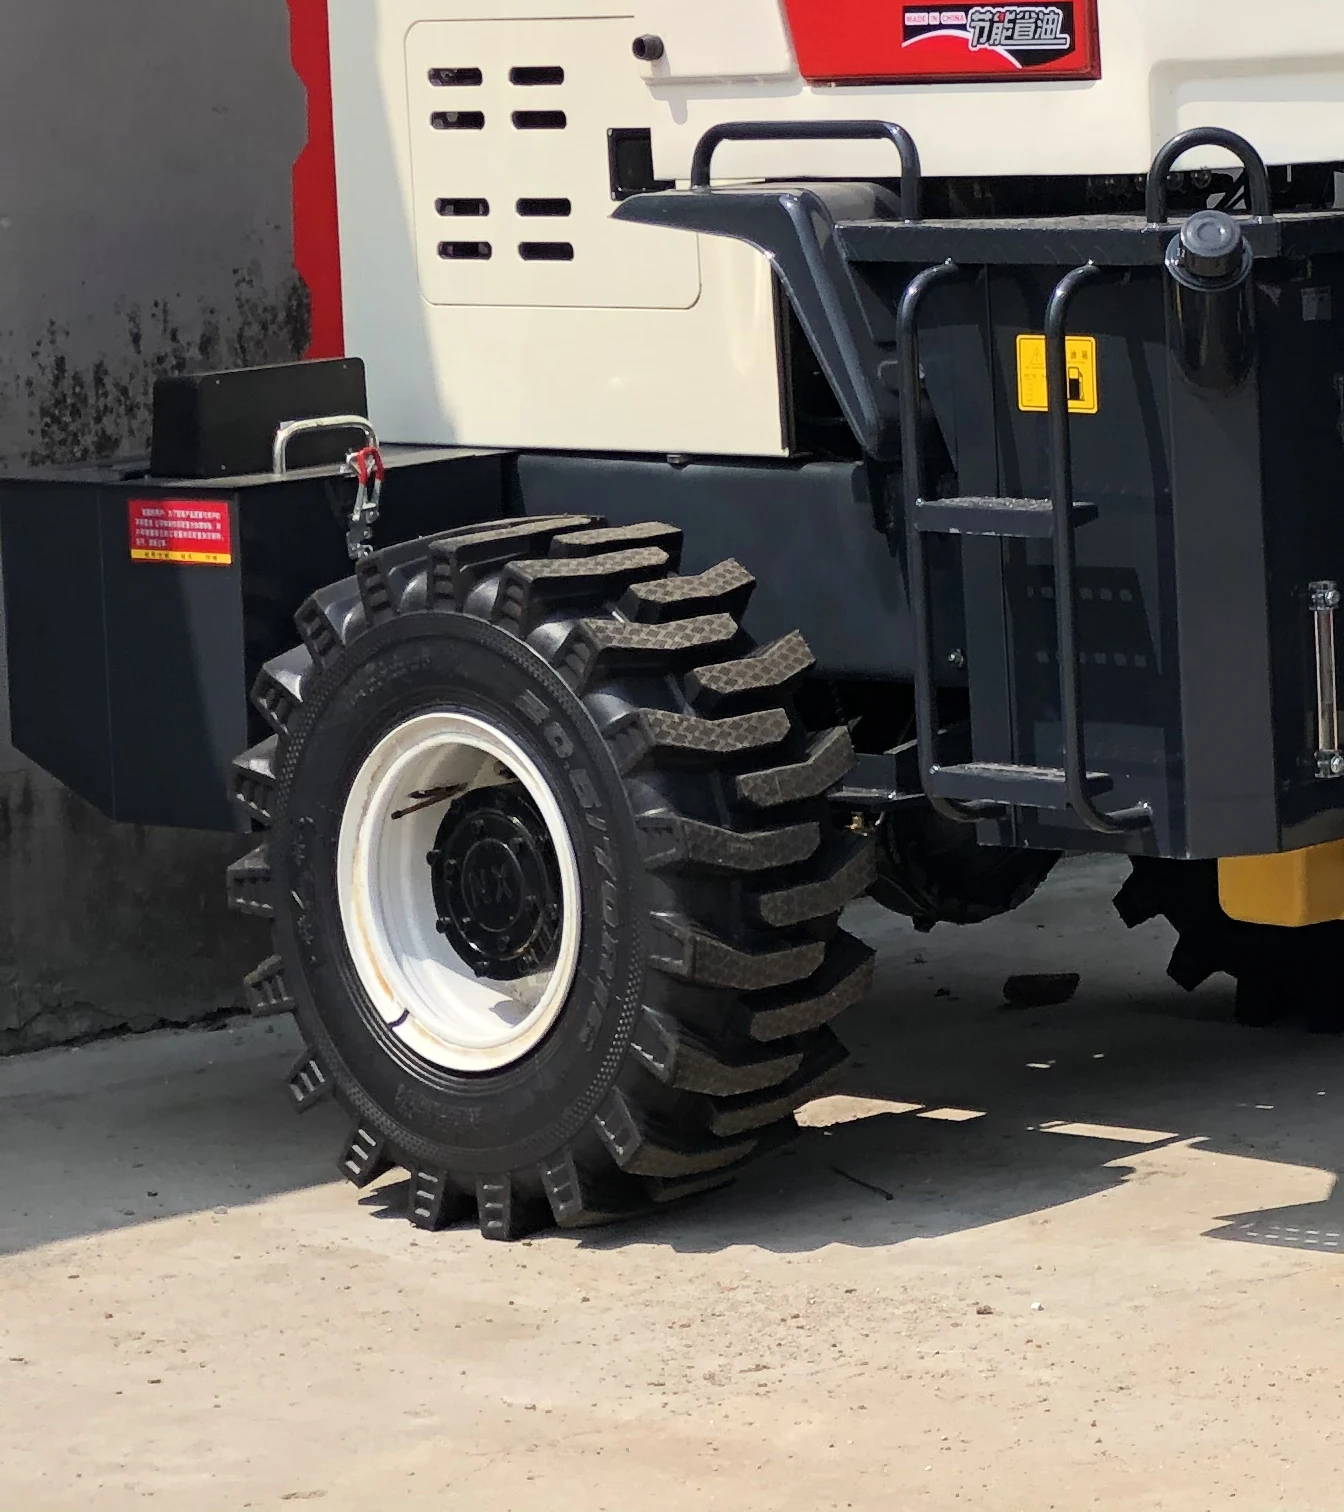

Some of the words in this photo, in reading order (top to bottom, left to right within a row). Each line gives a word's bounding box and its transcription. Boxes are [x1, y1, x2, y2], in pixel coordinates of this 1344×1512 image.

[905, 14, 928, 24] MADE
[930, 14, 939, 24] IN
[941, 13, 966, 23] CHINA
[969, 8, 1065, 48] 节能省油
